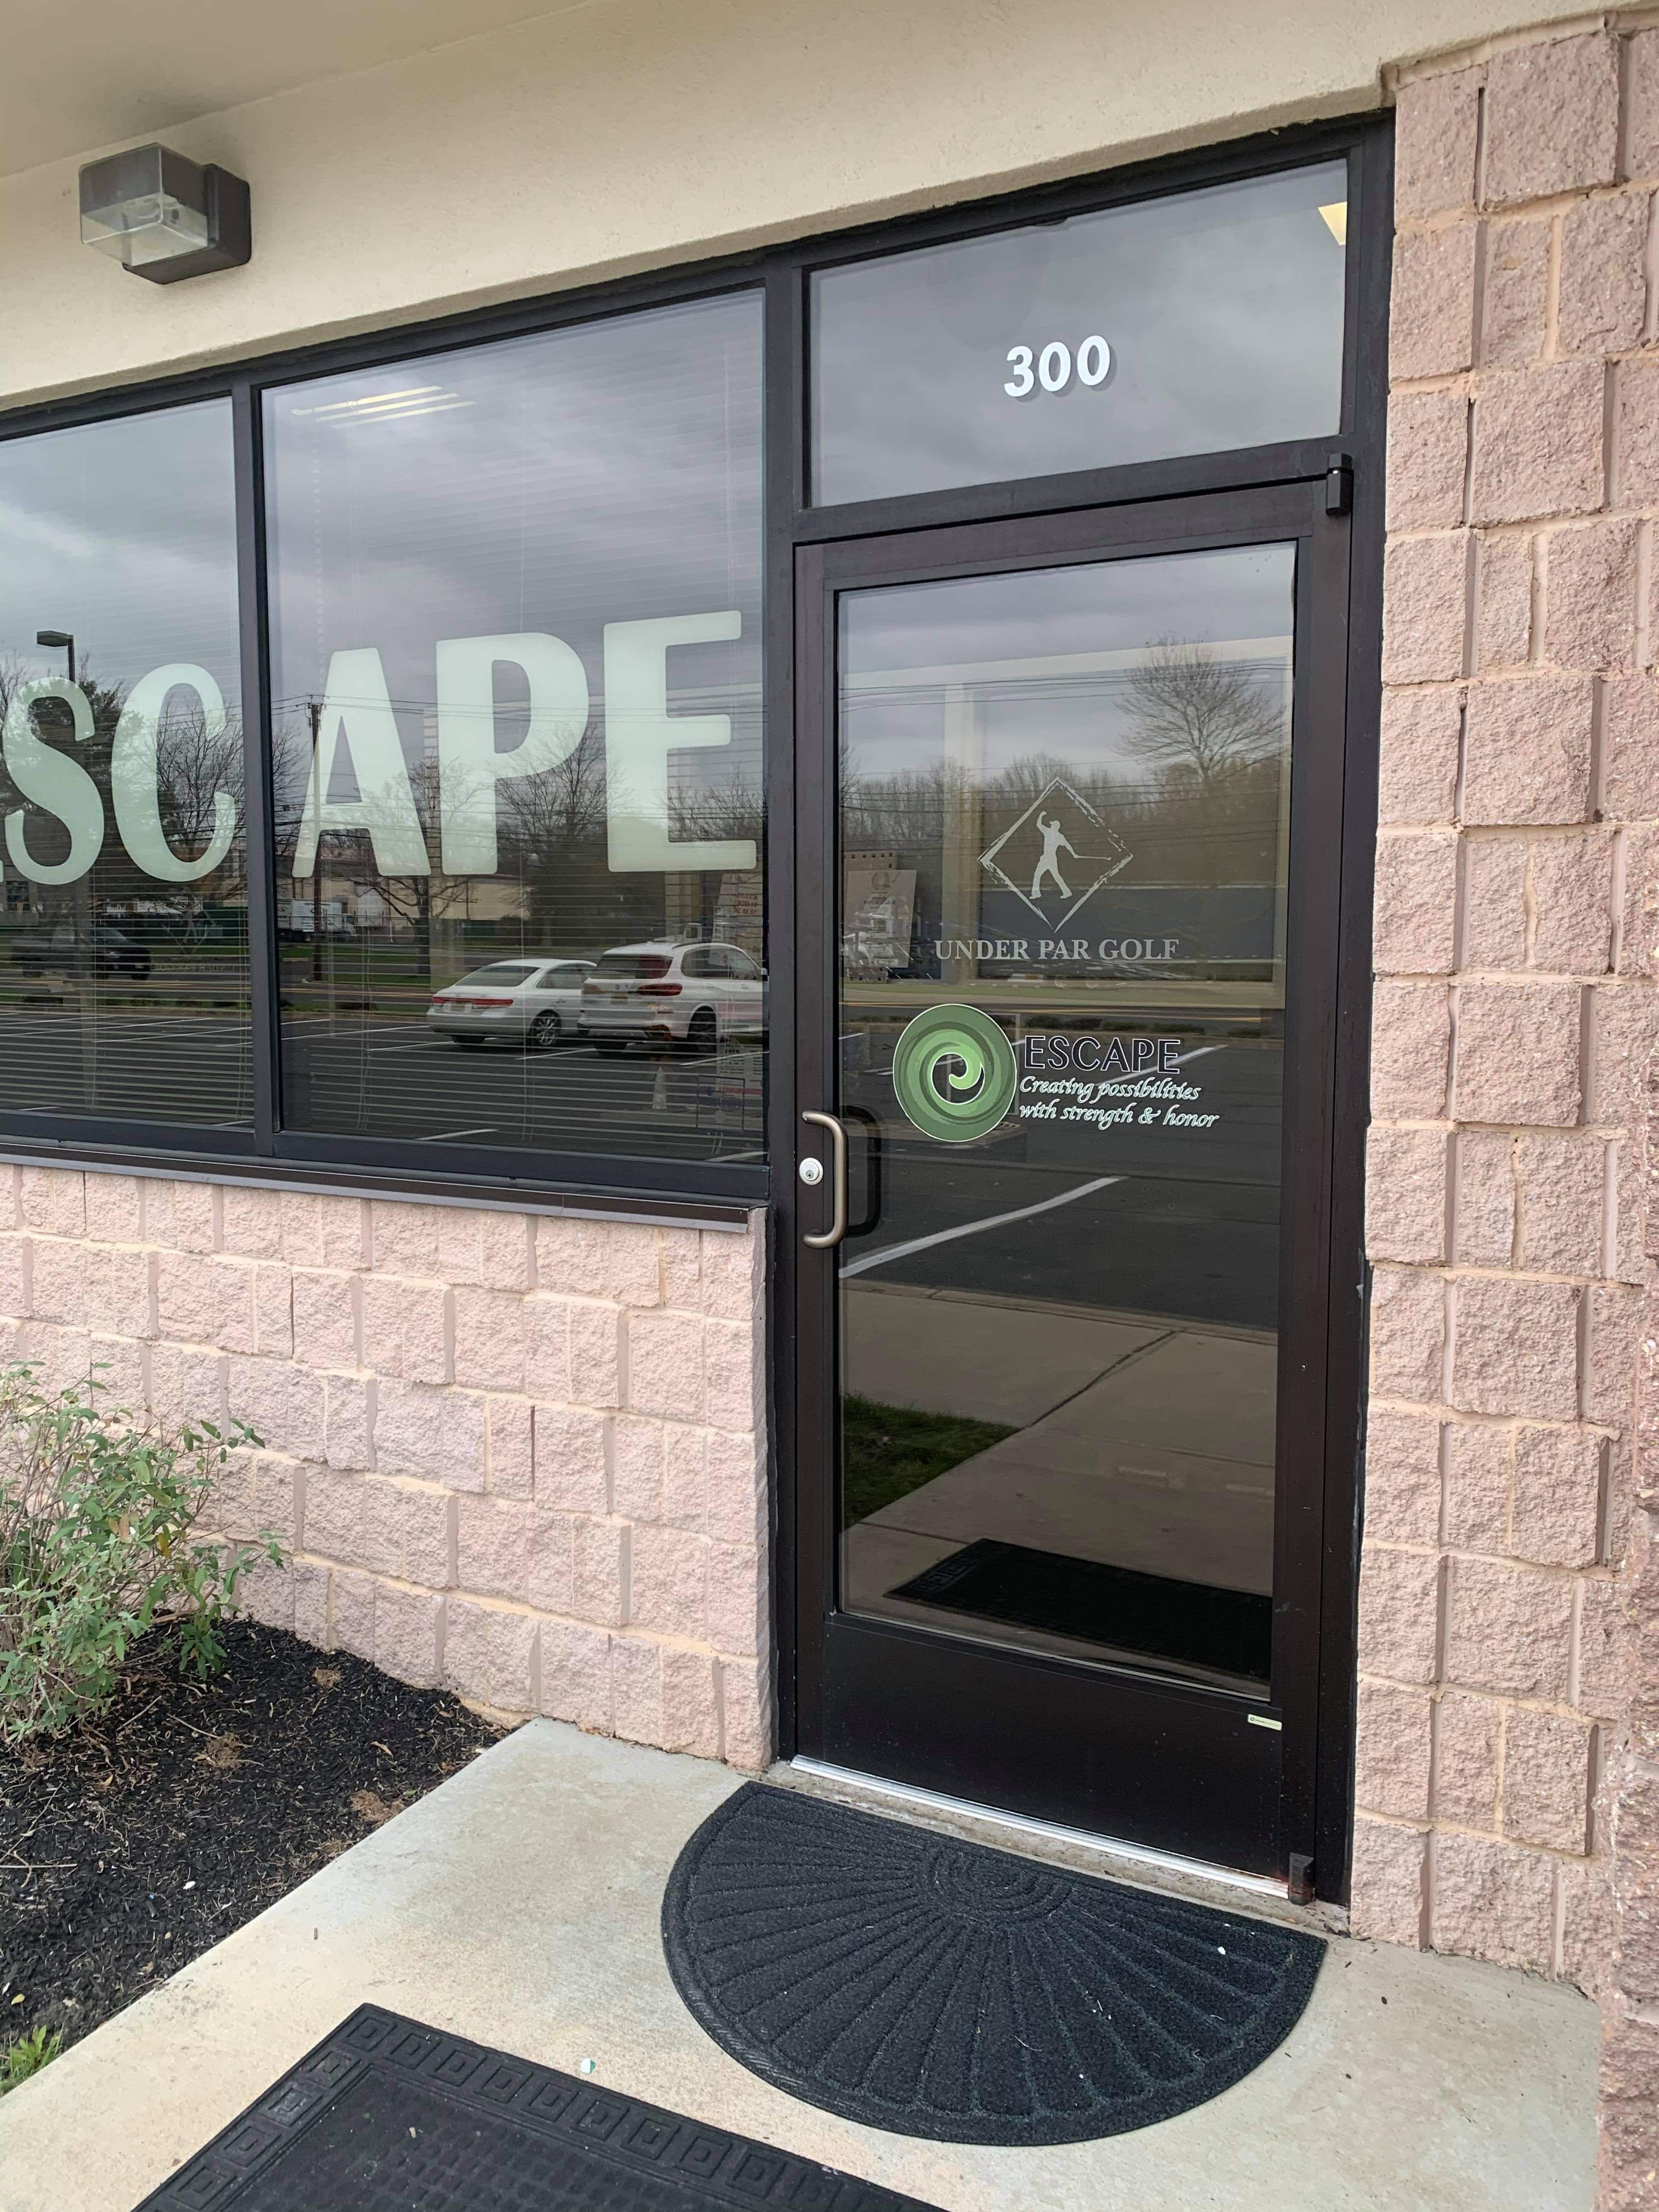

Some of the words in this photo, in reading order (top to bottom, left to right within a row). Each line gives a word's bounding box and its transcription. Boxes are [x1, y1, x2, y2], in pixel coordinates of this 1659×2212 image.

[1004, 335, 1110, 397] 300
[0, 611, 757, 885] SCAPE
[934, 940, 1030, 960] UNDER
[1039, 939, 1091, 960] PAR
[1099, 939, 1180, 960] GOLF
[1024, 1035, 1181, 1074] ESCAPE
[1020, 1076, 1095, 1103] Creating
[1089, 1077, 1202, 1104] possibilities
[1019, 1098, 1060, 1119] with
[1059, 1102, 1137, 1131] strength
[1138, 1107, 1161, 1124] &
[1163, 1104, 1220, 1128] honor
